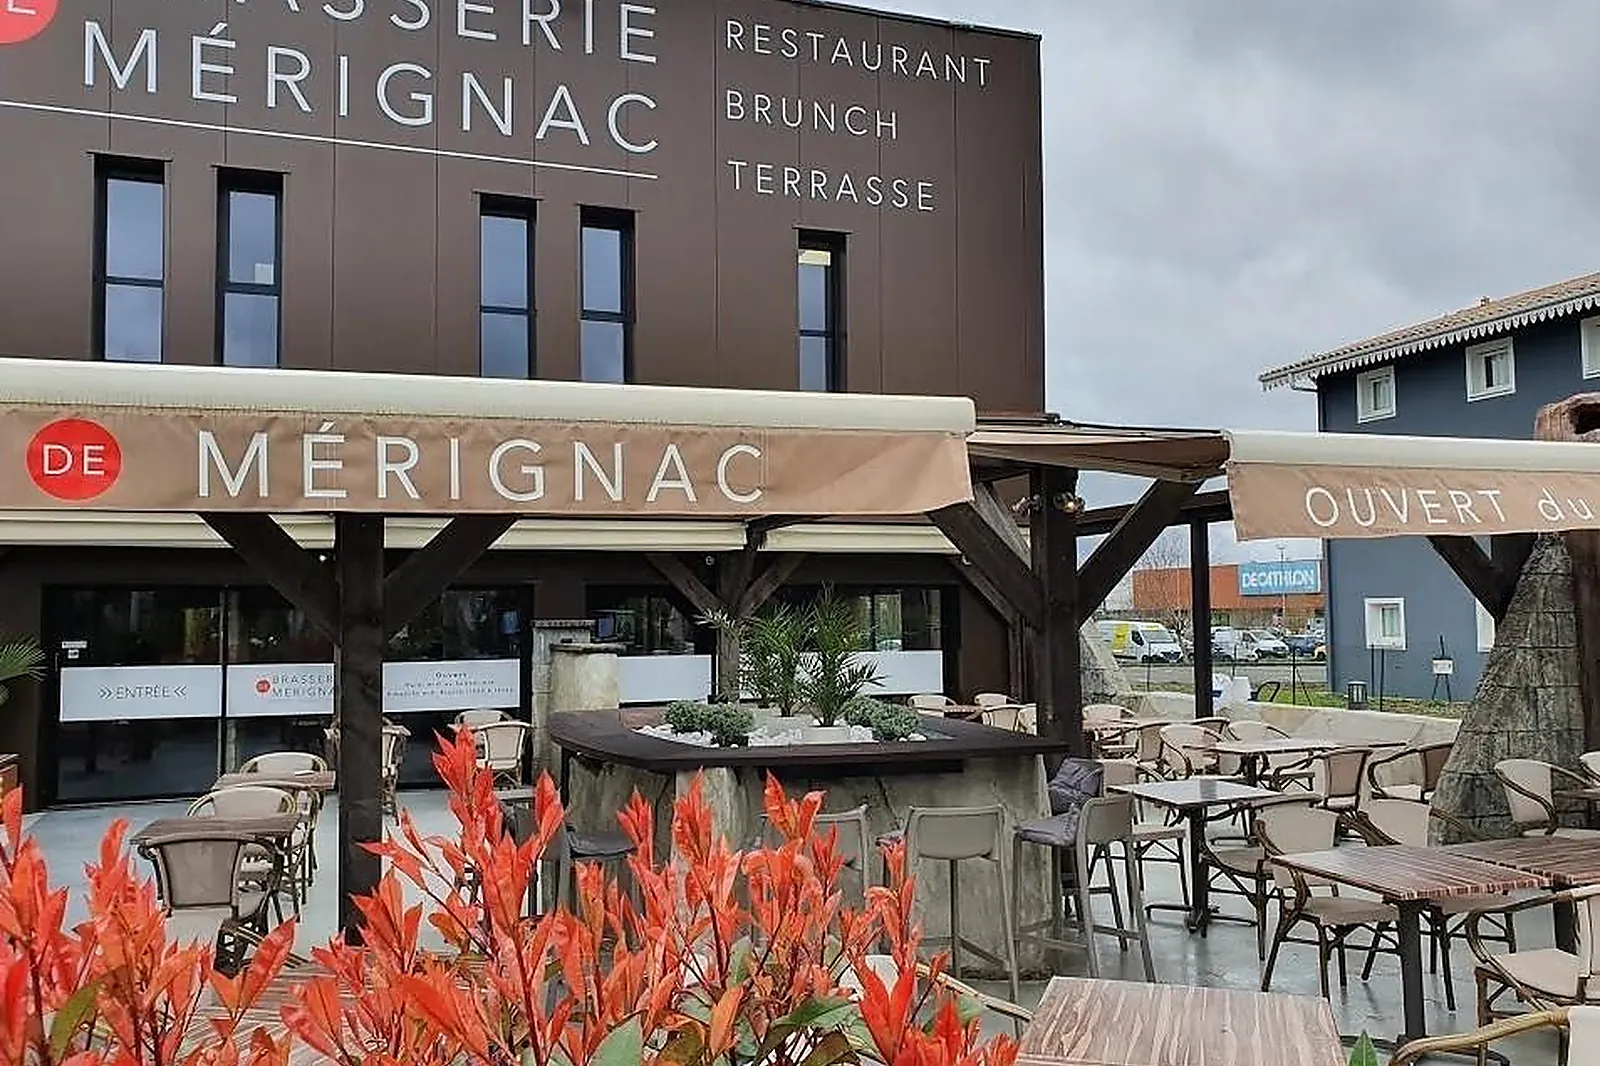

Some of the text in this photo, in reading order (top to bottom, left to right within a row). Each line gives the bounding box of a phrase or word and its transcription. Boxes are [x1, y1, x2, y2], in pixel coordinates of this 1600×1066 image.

[726, 20, 991, 86] RESTAURANT
[83, 20, 658, 153] MÉRIGNAC
[726, 89, 897, 140] BRUNCH
[727, 160, 935, 211] TERRASSE
[43, 420, 763, 502] DE MÉRIGNAC
[1305, 486, 1595, 527] OUVERT du
[115, 684, 170, 700] ENTRÉE
